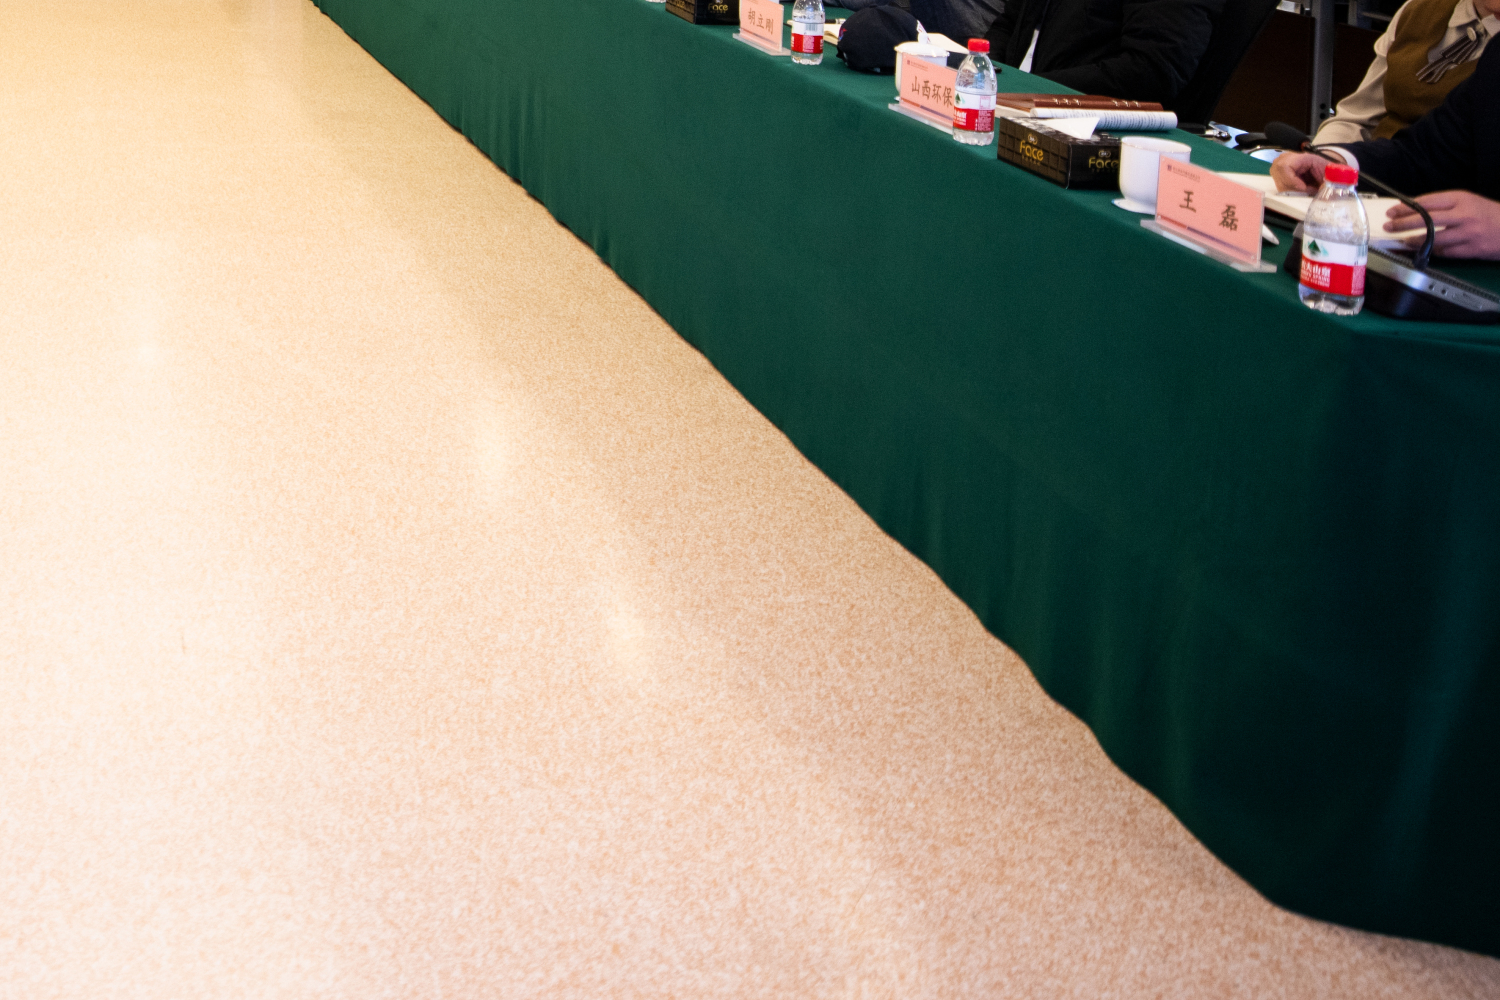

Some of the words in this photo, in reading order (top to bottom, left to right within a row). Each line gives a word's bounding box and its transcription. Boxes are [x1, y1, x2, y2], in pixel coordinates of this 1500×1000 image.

[911, 75, 953, 108] 山西环保
[1019, 139, 1044, 162] Face
[1178, 189, 1239, 232] 王磊
